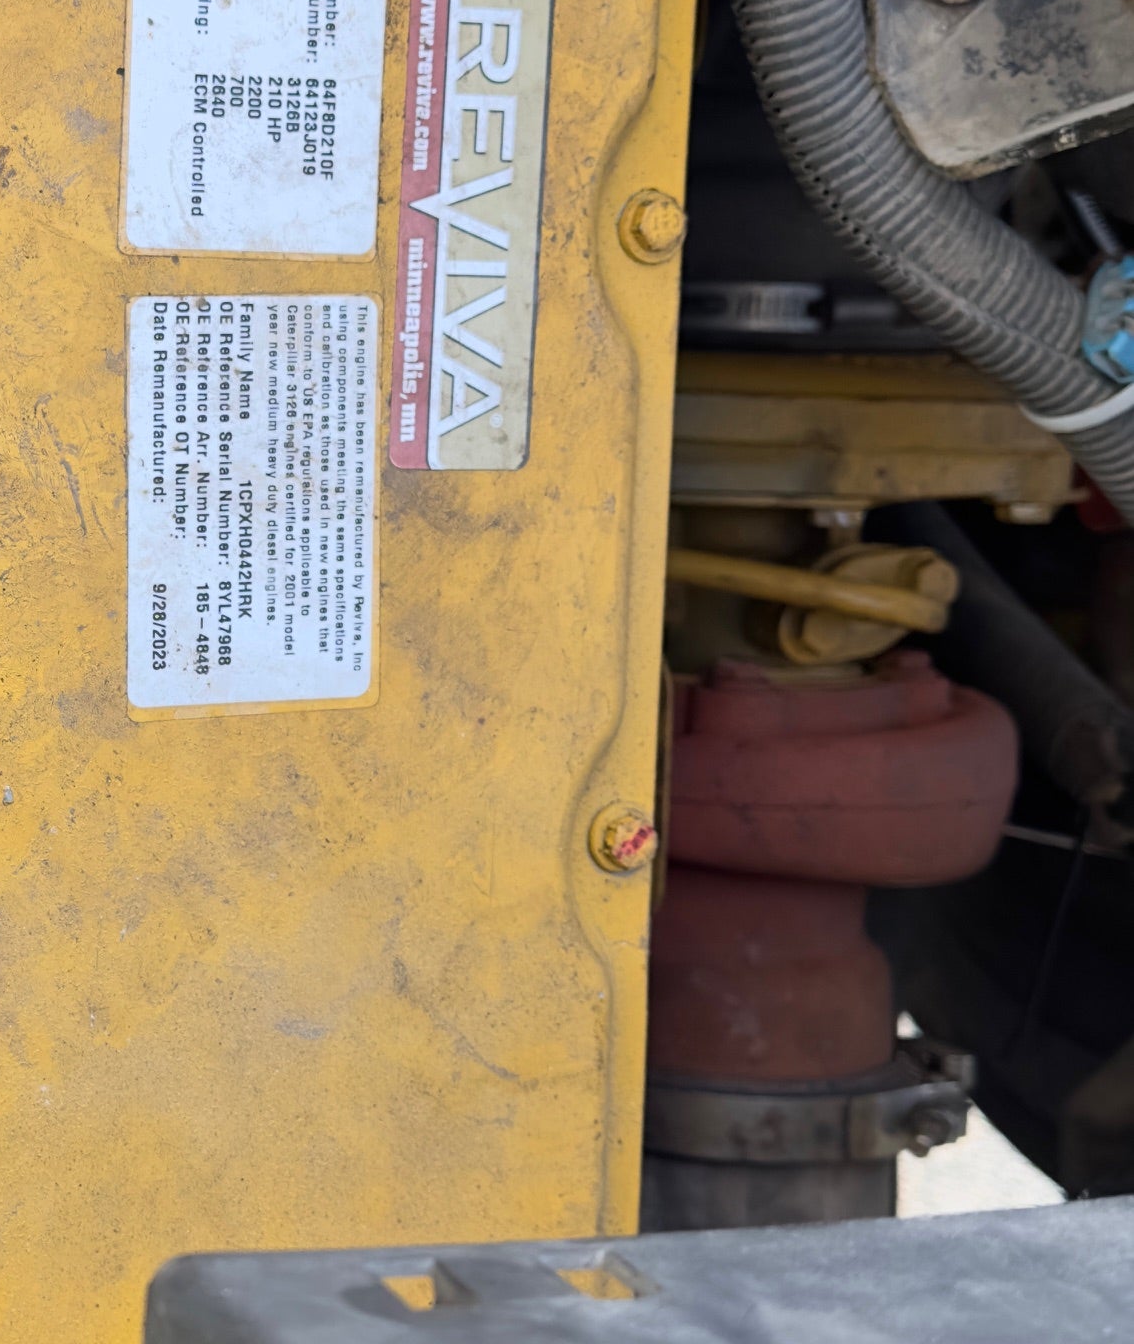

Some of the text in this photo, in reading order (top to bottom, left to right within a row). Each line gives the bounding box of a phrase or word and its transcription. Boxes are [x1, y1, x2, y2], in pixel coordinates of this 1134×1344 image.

[194, 74, 208, 114] ECM
[211, 74, 226, 118] 2640
[230, 76, 244, 108] 700
[248, 76, 262, 119] 2200
[267, 118, 282, 143] HP
[268, 77, 283, 109] 210
[286, 78, 301, 133] 3126B
[303, 78, 319, 176] 64123J019
[320, 79, 336, 180] 64F8D210F
[191, 122, 207, 216] Controlled
[408, 7, 522, 437] REVIVA
[174, 302, 190, 539] OE Reference OT Number:
[197, 334, 211, 423] Reference
[152, 302, 168, 670] Date Remanufactured: 9/28/2023
[197, 431, 210, 463] Arr.
[218, 302, 233, 666] OE Reference Serial Number: 8YL47968
[237, 303, 254, 618] Family Name 1CPXH0442HRK
[265, 305, 279, 625] year new medium heavy duty diesel engines.
[284, 305, 298, 655] Caterpillar 3126 engines certified for 2001 model
[300, 305, 314, 616] conform to US EPA regulations applicable to
[317, 305, 333, 652] and calibration as those used in new engines that
[334, 306, 349, 661] using components meeting the same specifications
[352, 306, 368, 671] This engine has been remanufactured by Reviva, Inc
[196, 472, 210, 547] Number:
